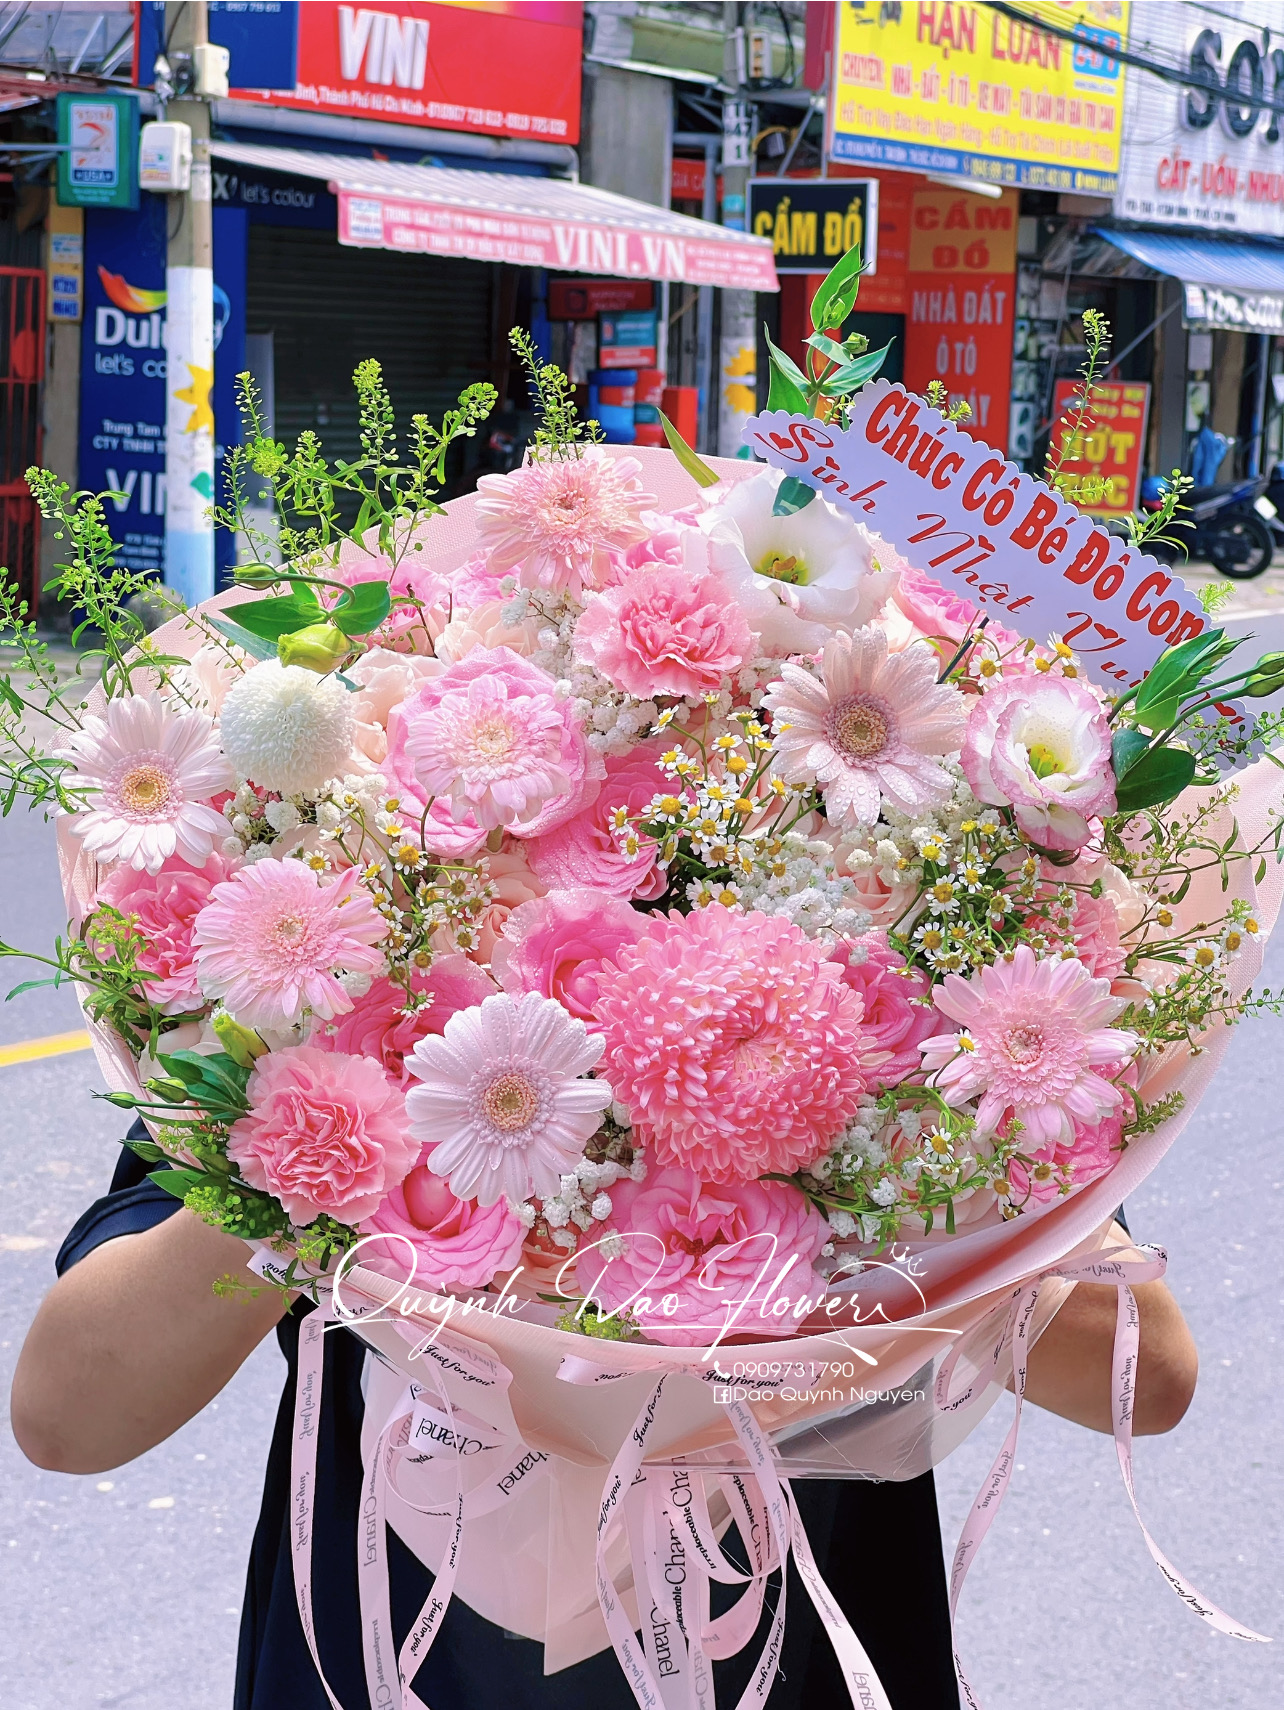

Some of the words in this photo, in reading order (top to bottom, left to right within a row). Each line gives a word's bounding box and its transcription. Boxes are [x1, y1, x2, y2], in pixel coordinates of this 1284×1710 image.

[338, 5, 430, 90] VINI
[553, 225, 686, 278] VINI.VN
[913, 284, 957, 323] NHÀ
[963, 280, 1006, 325] ĐẤT
[936, 335, 949, 375] Ô
[954, 335, 977, 376] TÔ
[92, 435, 119, 451] CTY
[865, 389, 966, 490] Chúc
[961, 458, 1021, 527] Cô
[1010, 492, 1072, 564] Bé
[1063, 530, 1130, 601] Đô
[753, 423, 887, 514] Sinh
[907, 513, 1035, 615] Nhật
[420, 1345, 449, 1368] Just
[463, 1375, 491, 1387] you
[416, 1418, 482, 1455] Chanel
[496, 1451, 551, 1495] hanel
[651, 1606, 680, 1678] Chanel
